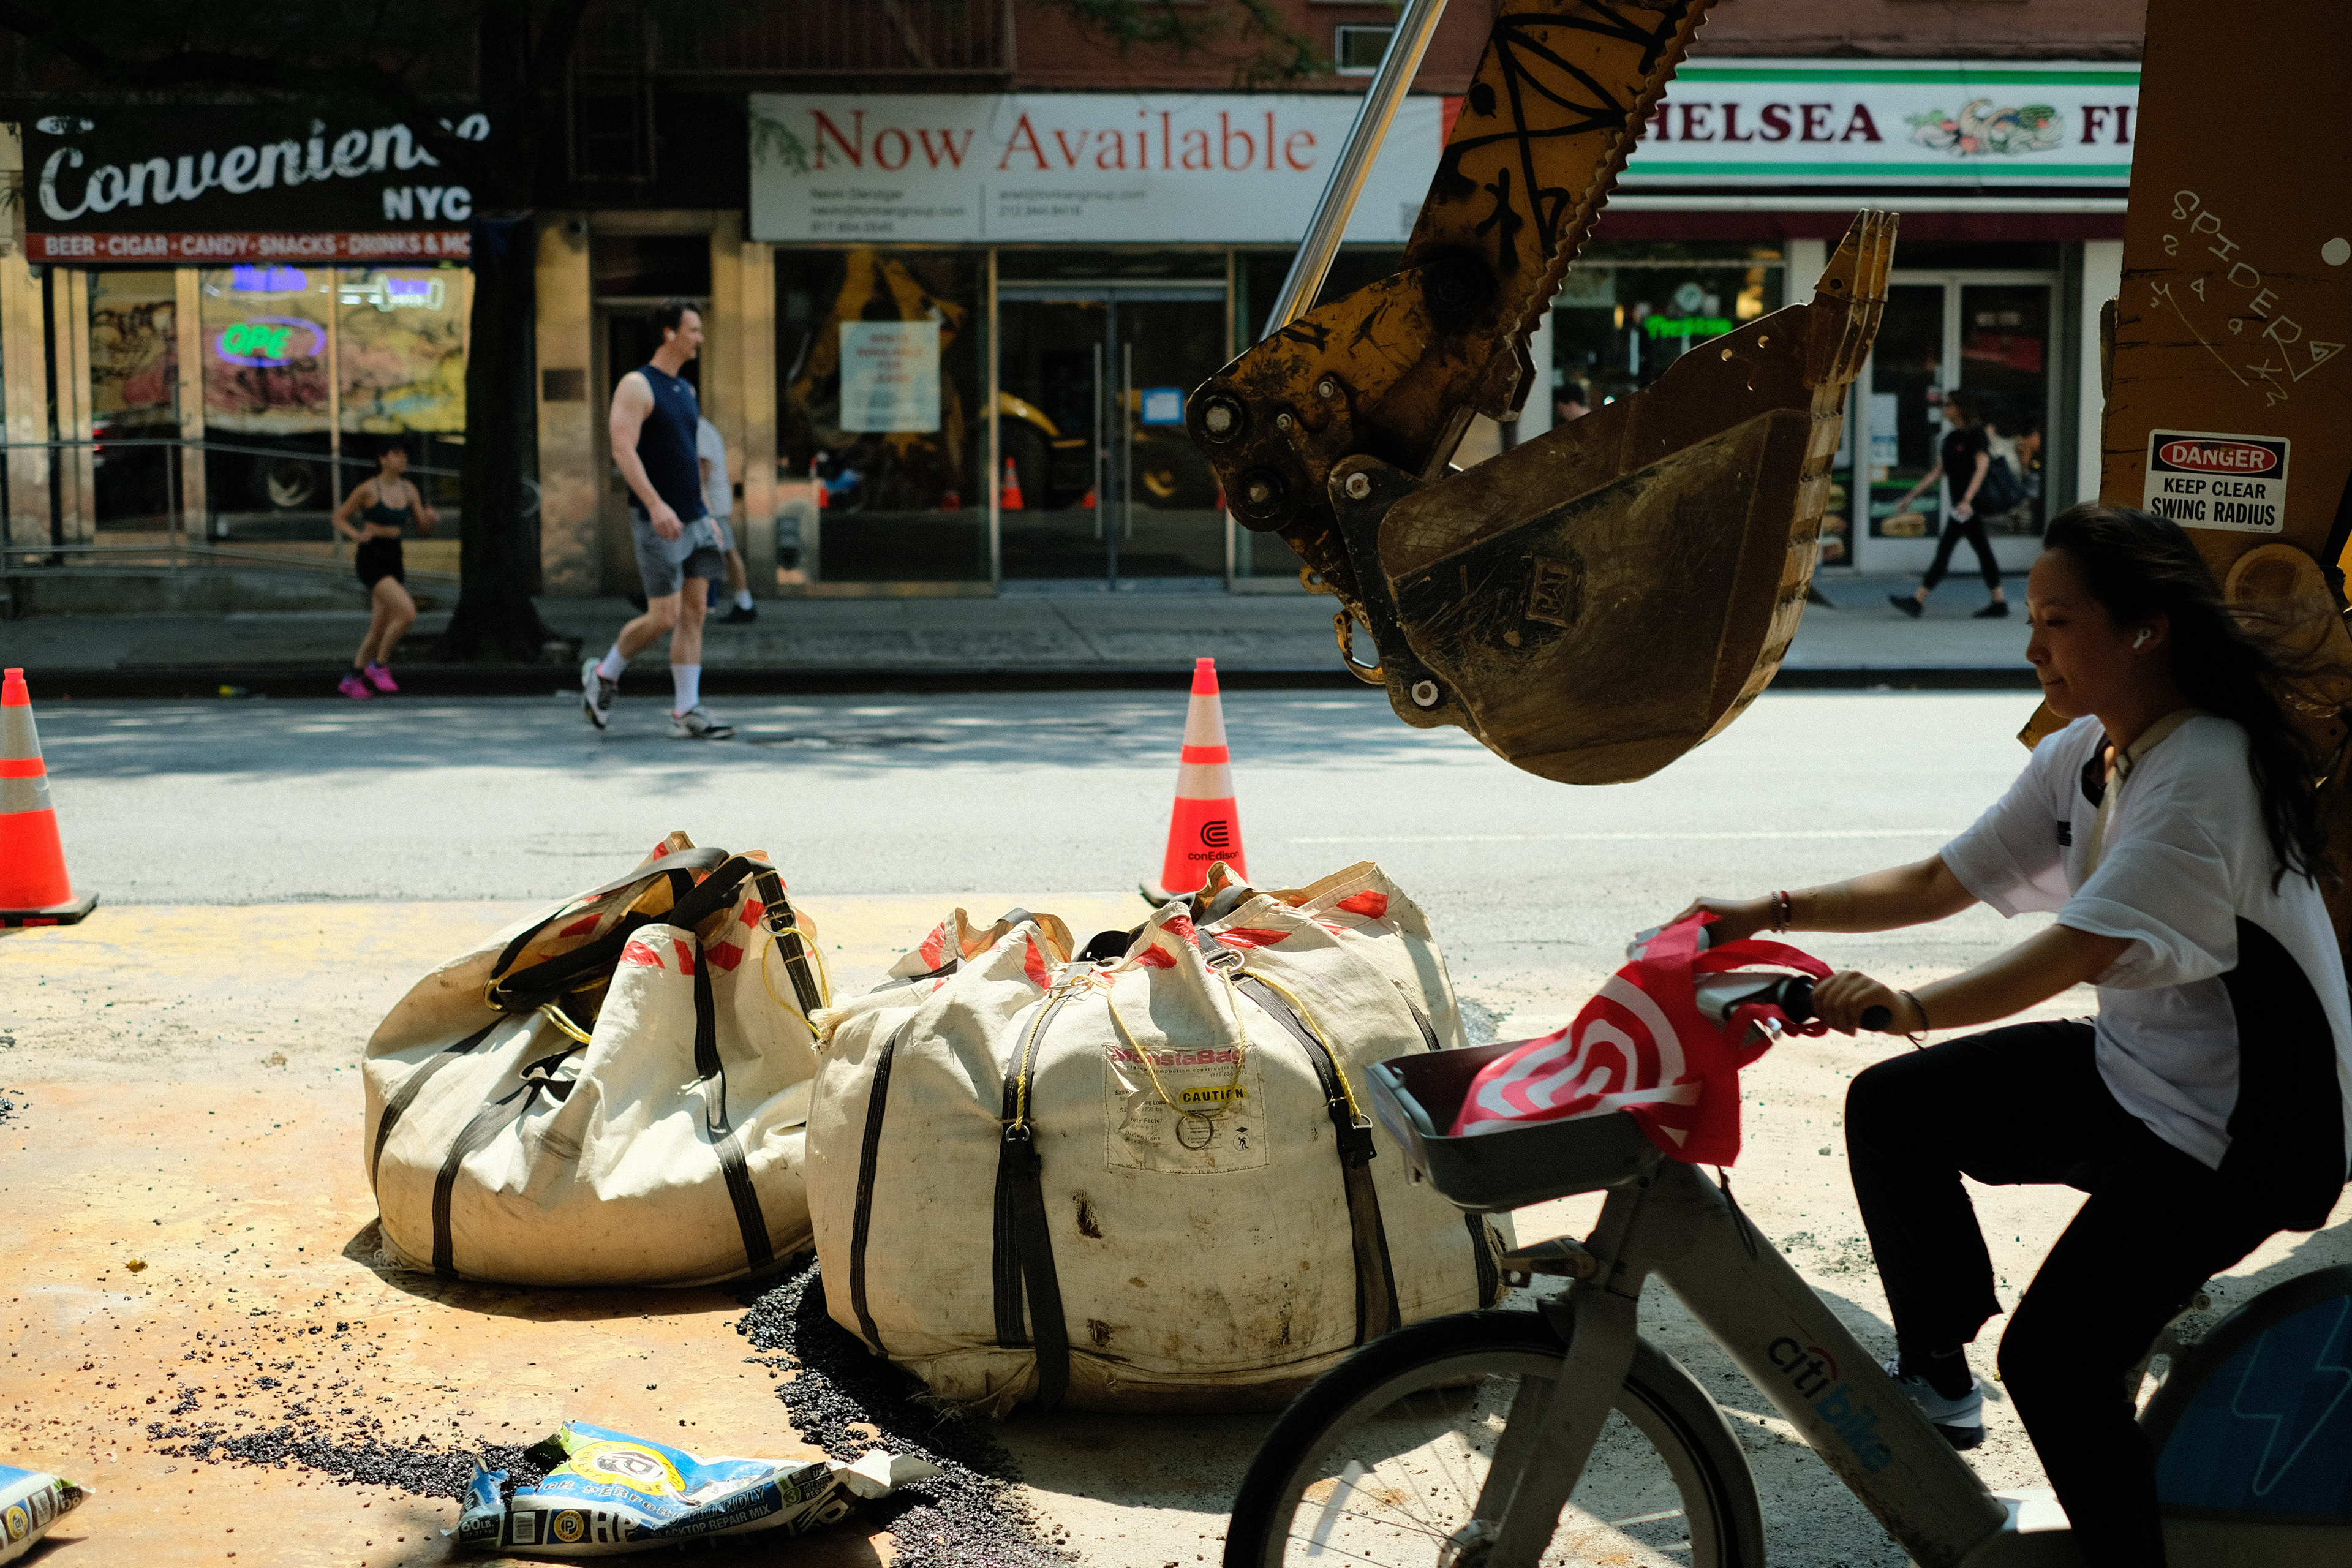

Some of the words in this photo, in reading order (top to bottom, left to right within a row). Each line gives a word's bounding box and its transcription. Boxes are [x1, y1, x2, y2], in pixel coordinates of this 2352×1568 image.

[809, 109, 974, 171] Now
[997, 110, 1317, 171] Available
[39, 113, 490, 222] Convenien
[383, 186, 472, 221] NYC
[44, 236, 96, 257] BEER
[108, 236, 168, 257] CIGAR
[181, 236, 247, 256] CANDY
[258, 235, 336, 255] SNACKS
[2172, 445, 2265, 469] DANGER
[2163, 478, 2206, 494] KEEP
[2212, 481, 2266, 499] CLEAR
[2150, 497, 2206, 521] SWING
[2214, 501, 2275, 526] RADIUS
[1188, 851, 1239, 861] conEdison
[1125, 1129, 1161, 1141] Dimensions
[1768, 1336, 1831, 1399] citi
[1816, 1384, 1893, 1471] bike
[591, 1510, 641, 1543] HP
[650, 1522, 707, 1539] BLACKTOP
[709, 1512, 747, 1532] REPAIR
[749, 1504, 771, 1519] MIX
